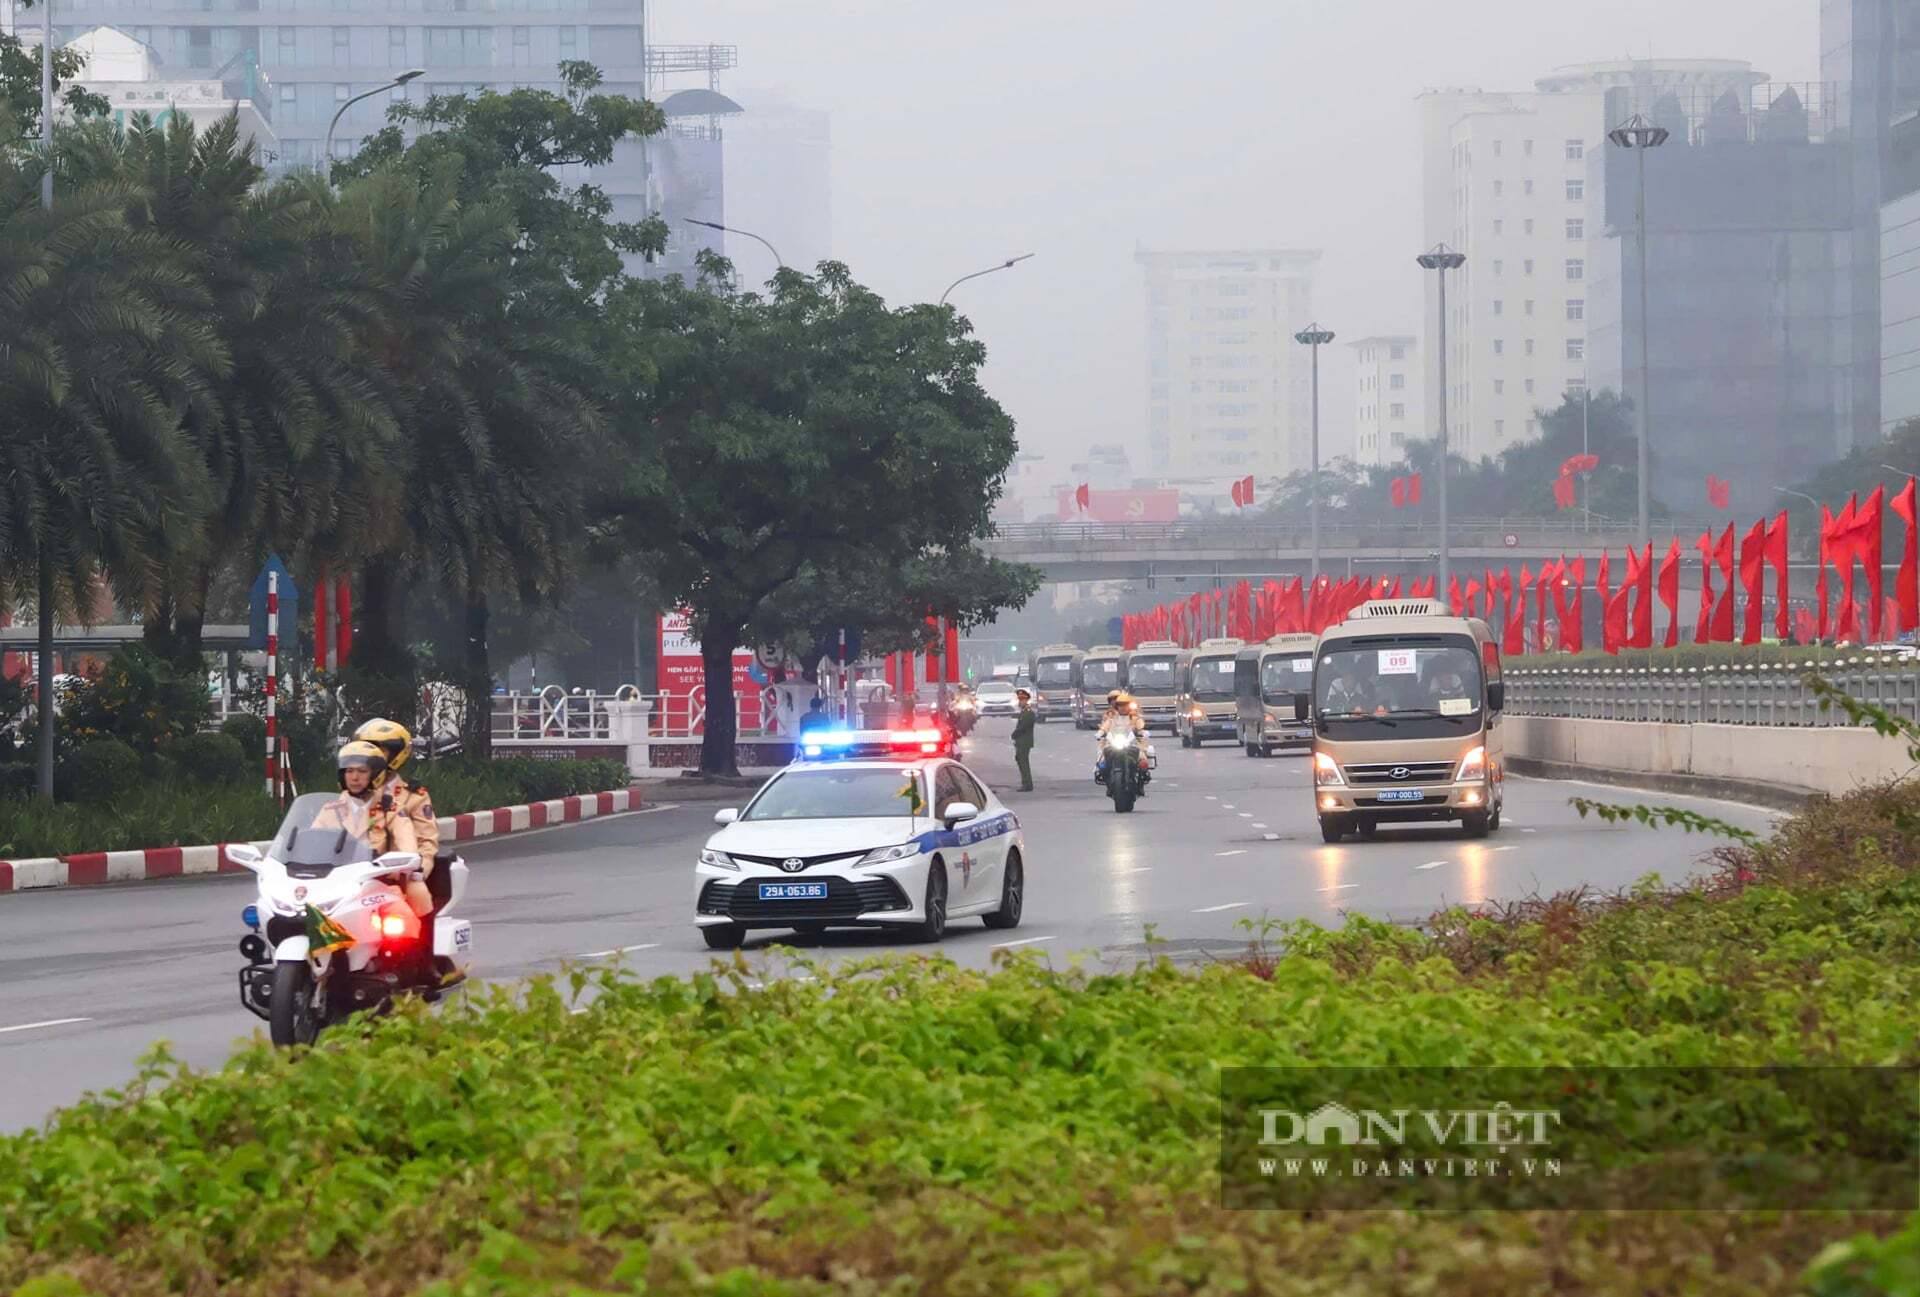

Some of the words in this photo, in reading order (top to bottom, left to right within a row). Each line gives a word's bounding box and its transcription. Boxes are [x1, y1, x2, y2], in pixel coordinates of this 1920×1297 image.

[1390, 656, 1407, 667] 09
[765, 886, 821, 897] 29A-063.86
[361, 895, 385, 906] CSGT
